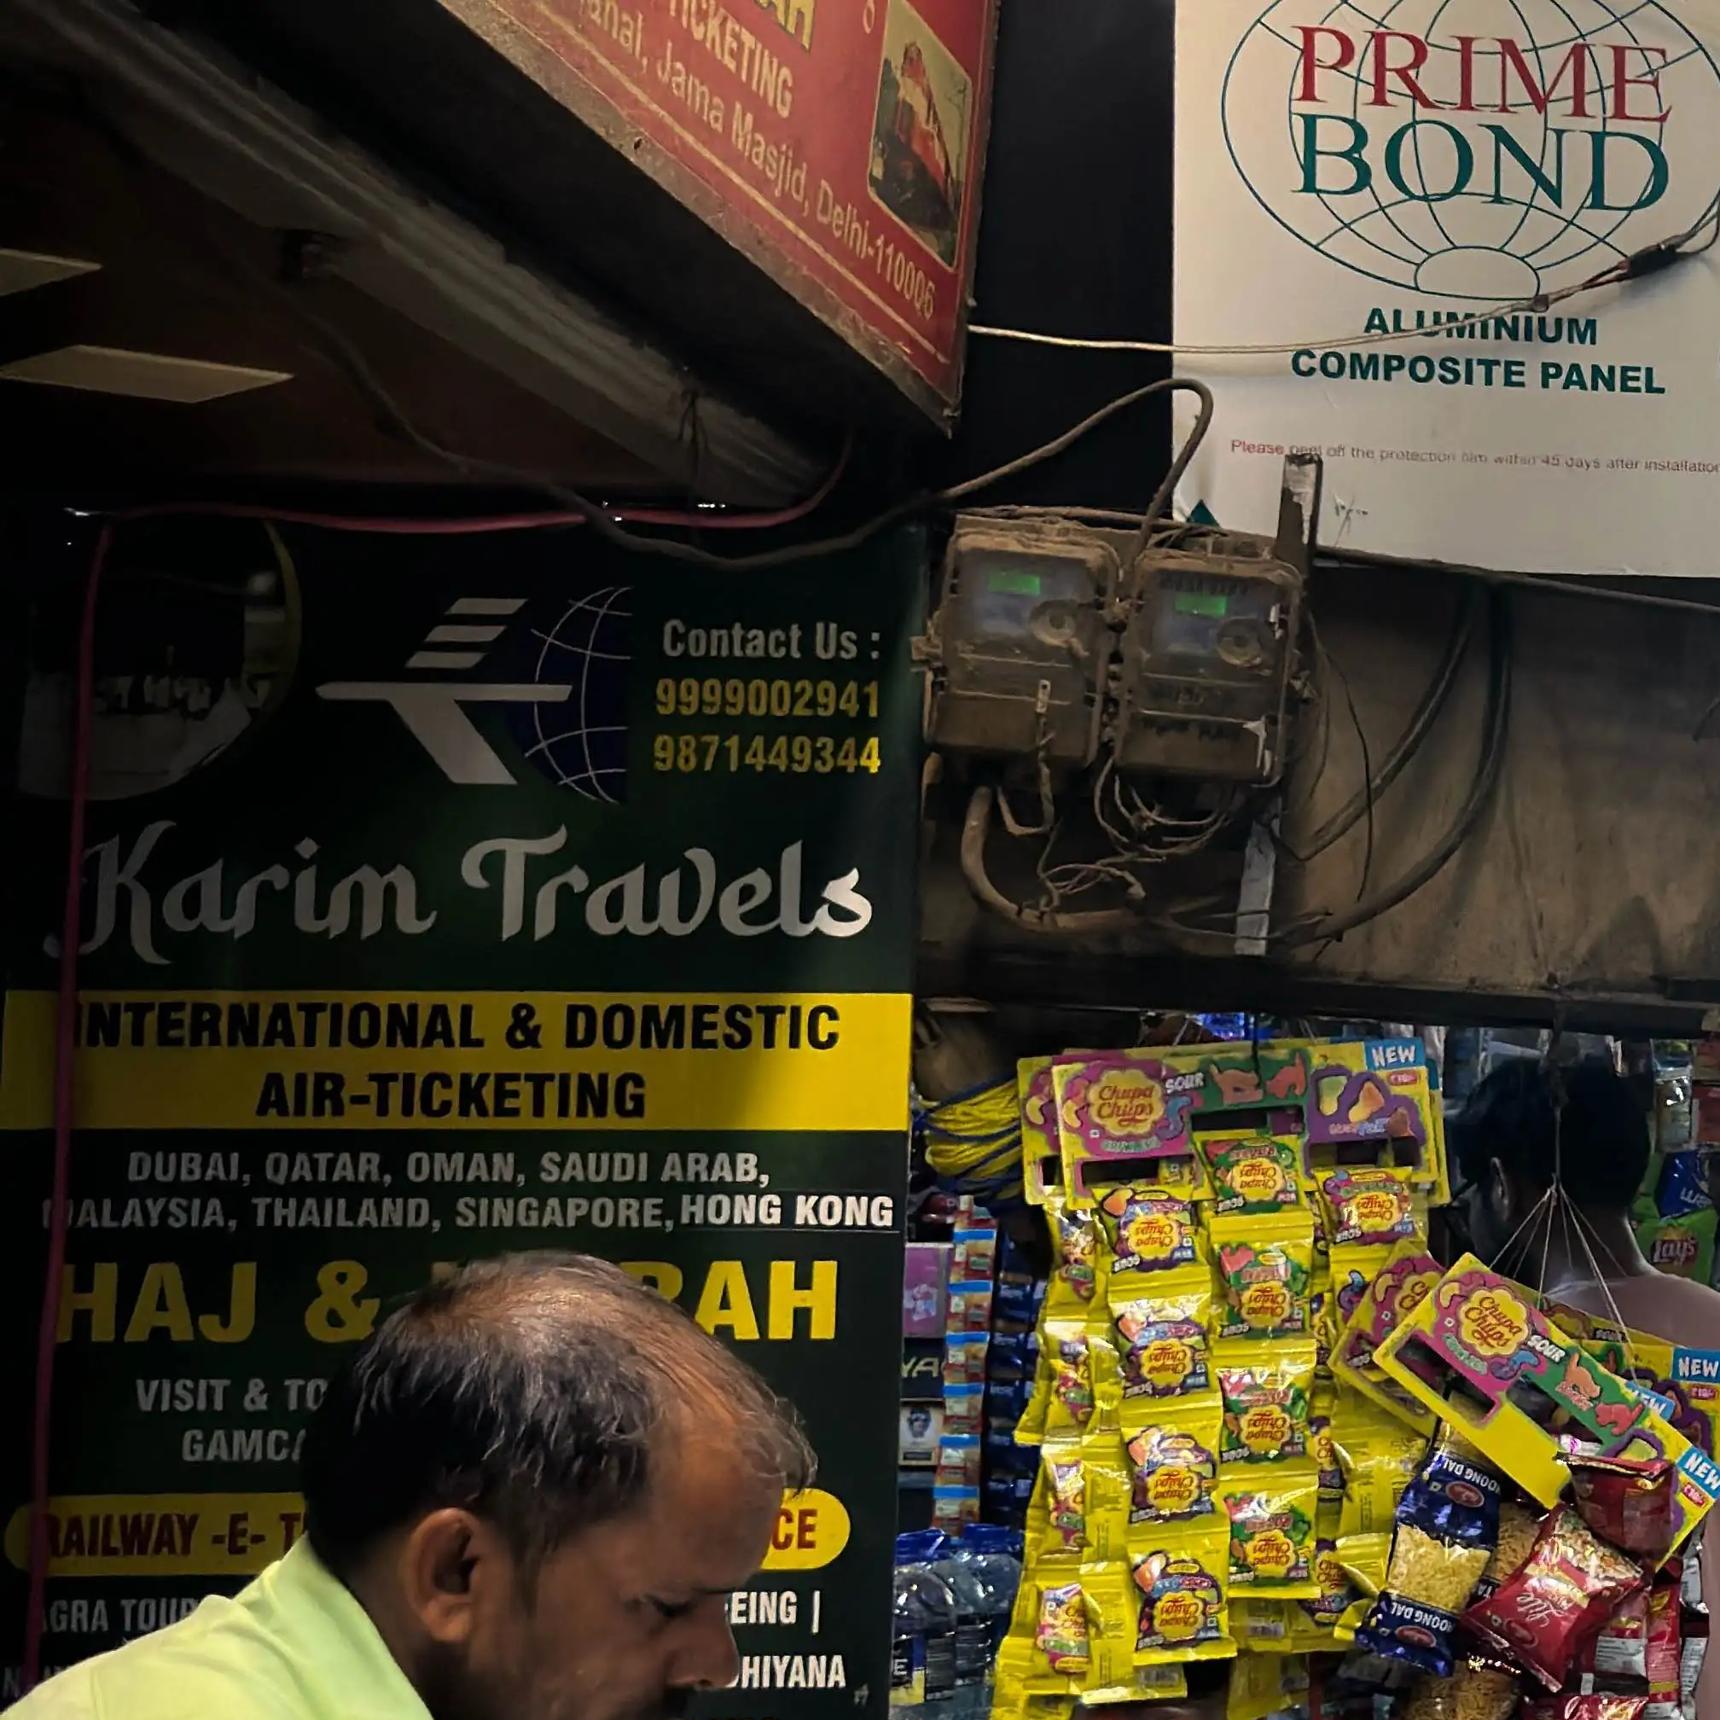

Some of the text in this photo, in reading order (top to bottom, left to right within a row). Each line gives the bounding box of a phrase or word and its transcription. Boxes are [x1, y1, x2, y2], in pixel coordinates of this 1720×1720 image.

[668, 0, 794, 118] ICKETING
[1291, 25, 1674, 124] PRIME
[656, 41, 936, 321] Jama Masjid, Delhi-110006
[1291, 112, 1670, 212] BOND
[1363, 307, 1598, 345] ALUMINIUM
[1291, 350, 1666, 395] COMPOSITE PANEL
[1231, 439, 1284, 455] Please
[1351, 446, 1376, 459] the
[662, 619, 801, 660] Contact
[815, 620, 860, 660] Us
[655, 679, 882, 720] 9999002941
[653, 735, 882, 775] 9871449344
[44, 820, 874, 967] Karim Travels
[76, 1001, 842, 1052] INTERNATIONAL & DOMESTIC
[1370, 1045, 1416, 1068] NEW
[256, 1070, 647, 1120] AIR-TICKETING
[1098, 1084, 1154, 1103] Chupa
[1164, 1073, 1205, 1093] SOUR
[1096, 1101, 1154, 1126] Chups
[127, 1151, 771, 1188] DUBAI, QATAR, OMAN, SAUDI ARAB,
[256, 1196, 441, 1235] THAILAND,
[454, 1196, 675, 1233] SINGAPORE,
[680, 1193, 782, 1227] HONG
[794, 1193, 895, 1228] KONG
[56, 1259, 382, 1345] HAJ &
[1478, 1295, 1523, 1338] Chupa
[1527, 1334, 1566, 1364] SOUR
[1677, 1355, 1719, 1378] NEW
[136, 1379, 328, 1412] VISIT & TO
[1464, 1466, 1501, 1492] OONG
[42, 1598, 111, 1634] GRA
